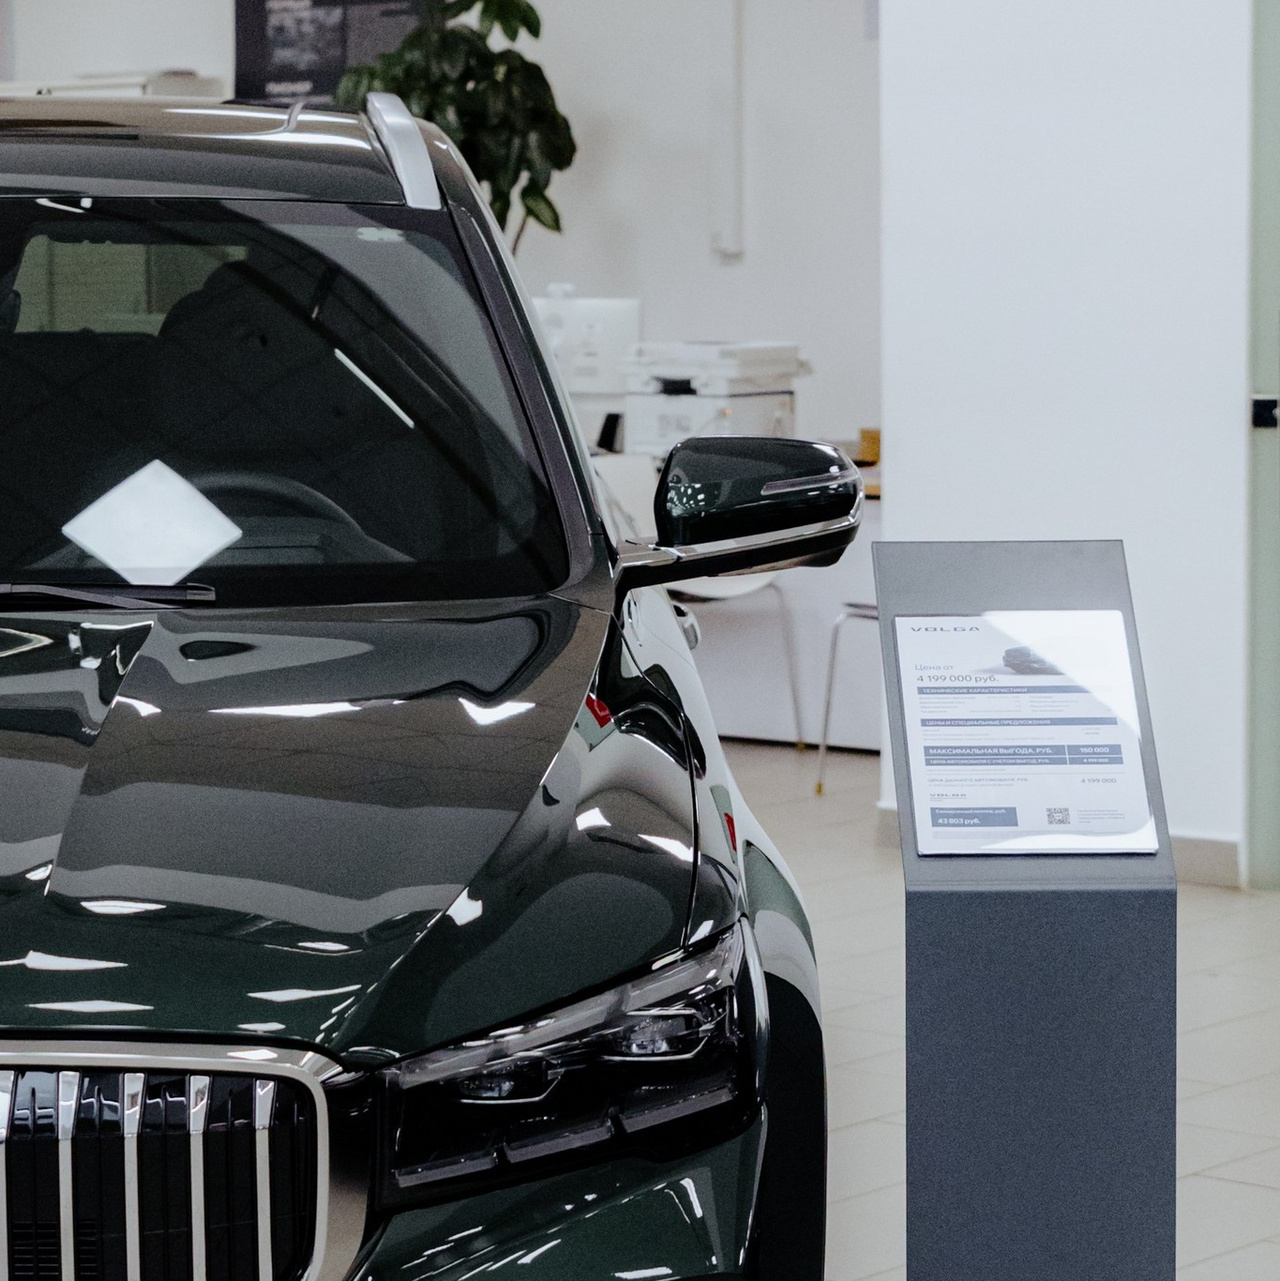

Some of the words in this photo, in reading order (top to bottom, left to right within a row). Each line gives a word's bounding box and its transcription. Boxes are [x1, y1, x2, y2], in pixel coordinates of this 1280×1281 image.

[910, 625, 981, 633] VOLGA
[914, 664, 941, 672] Цена
[916, 674, 924, 682] 4
[927, 674, 947, 682] 199
[949, 674, 972, 682] 000
[974, 674, 999, 684] руб.
[964, 818, 982, 826] руб.
